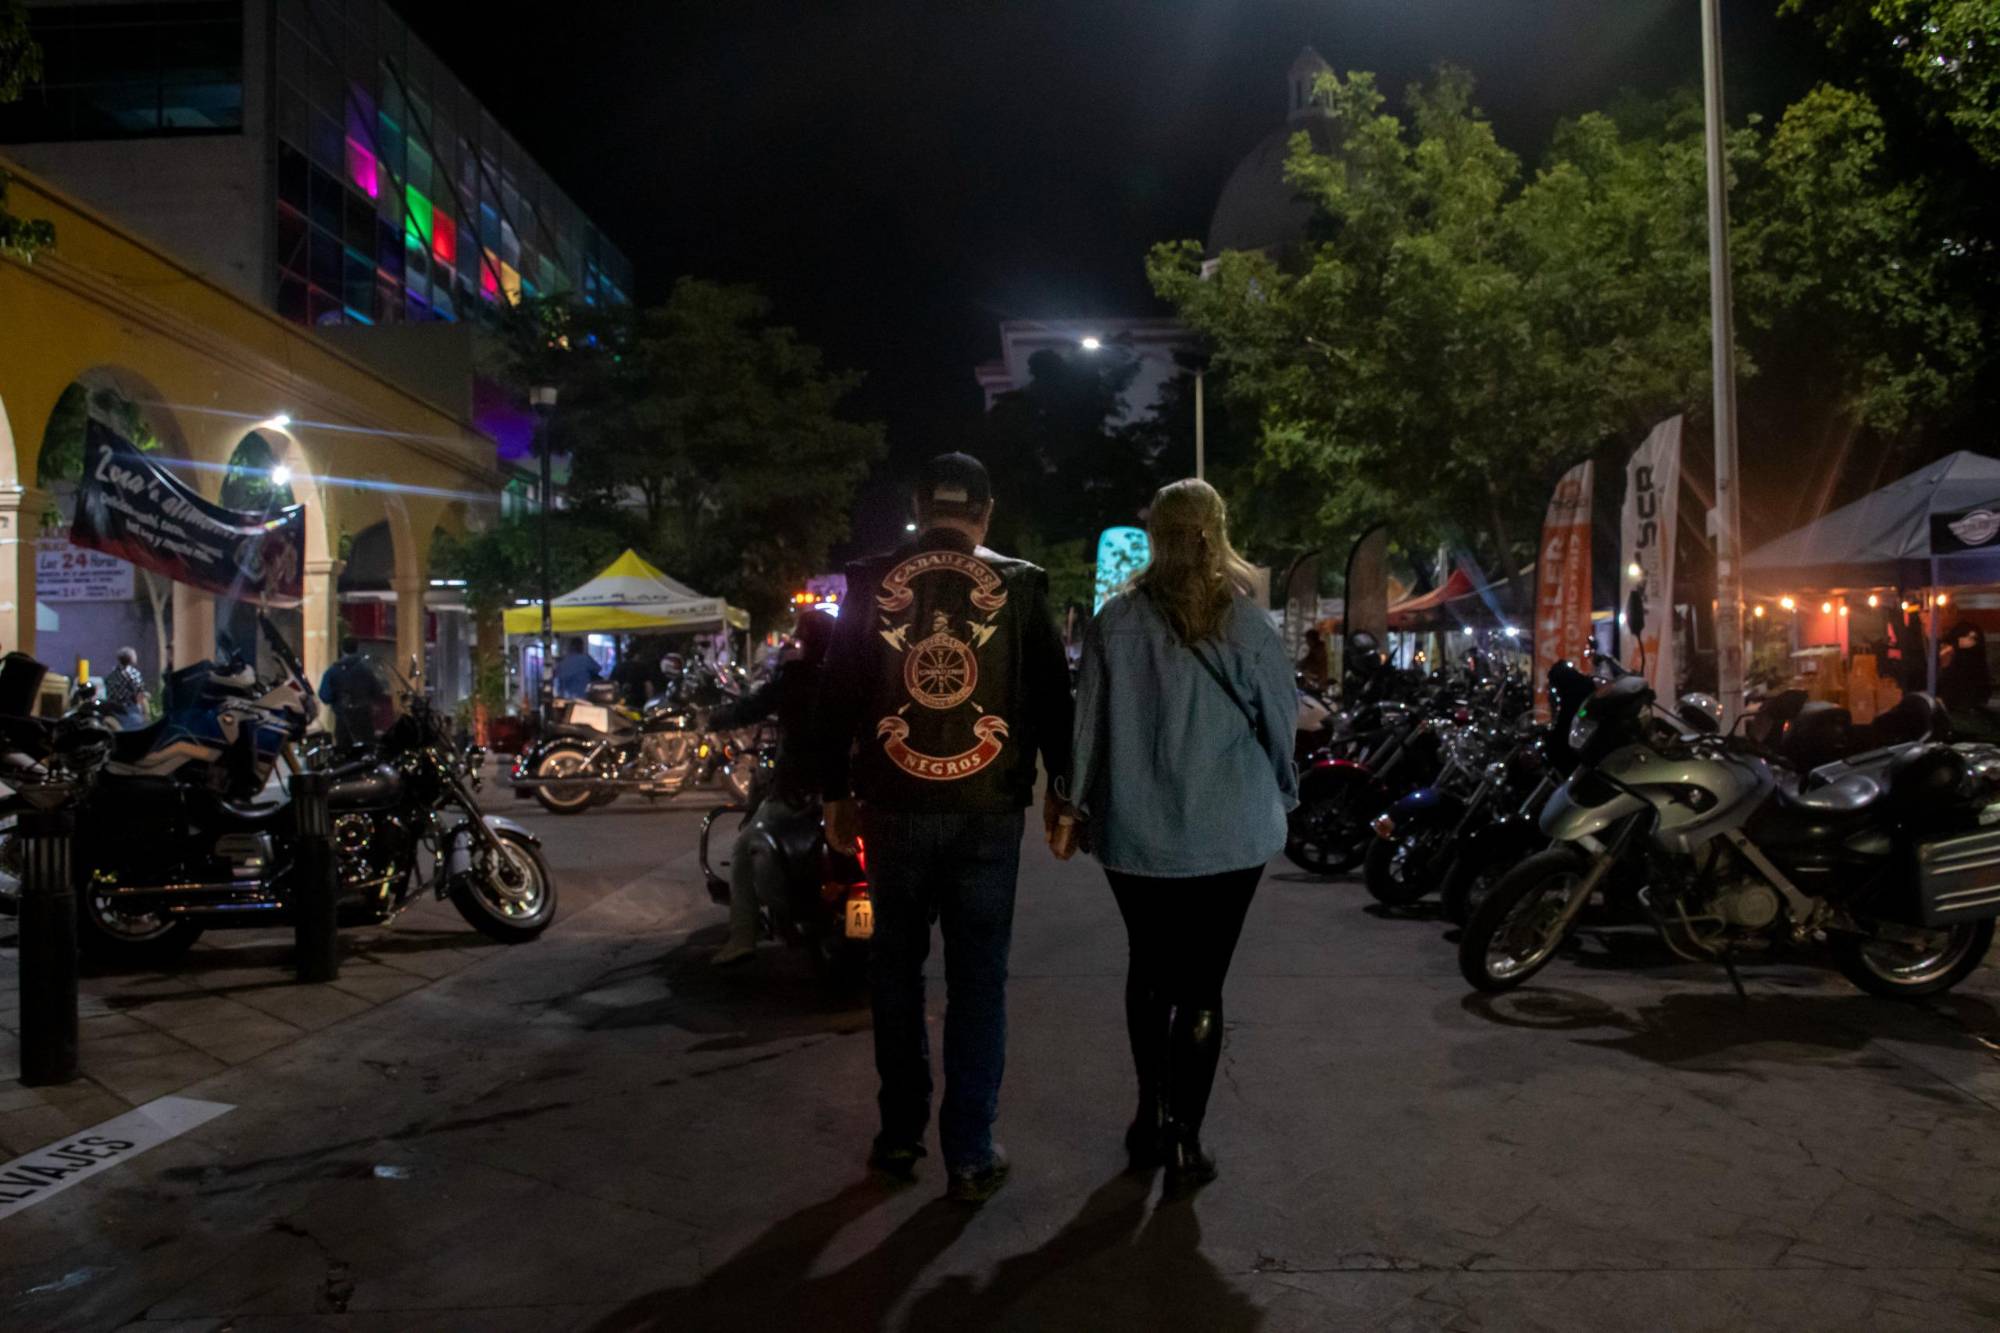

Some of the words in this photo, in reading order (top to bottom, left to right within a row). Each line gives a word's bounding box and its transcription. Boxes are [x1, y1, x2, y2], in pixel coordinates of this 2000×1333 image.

[62, 553, 87, 569] 24
[904, 752, 982, 776] NEGROS
[0, 1136, 136, 1204] LVAJES
